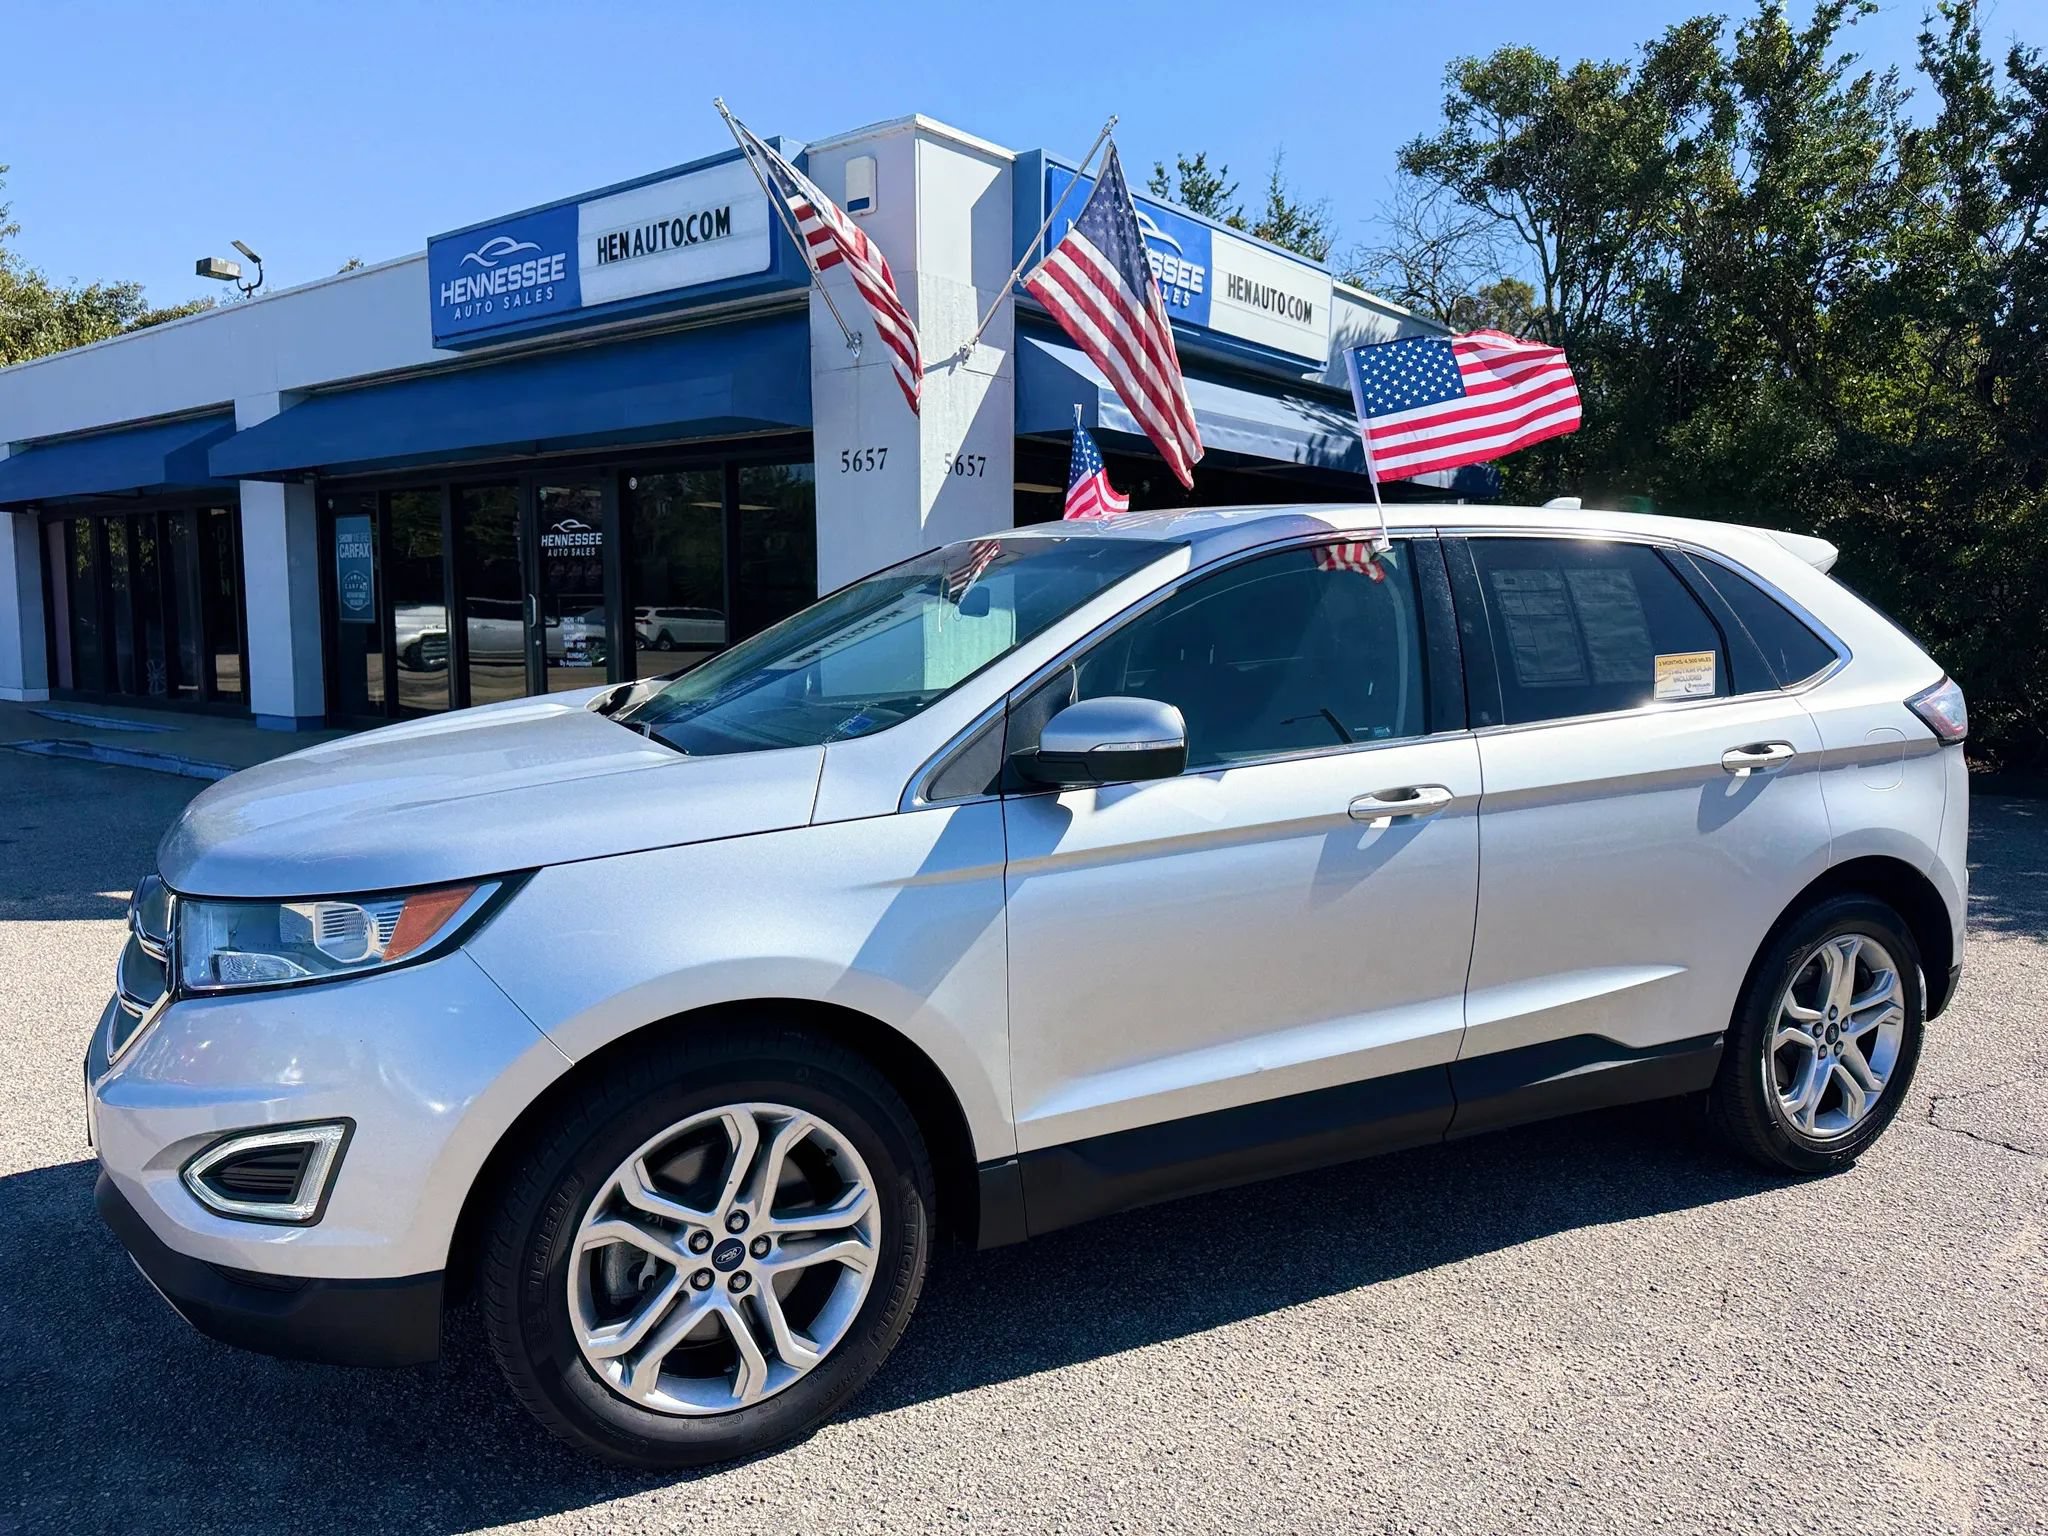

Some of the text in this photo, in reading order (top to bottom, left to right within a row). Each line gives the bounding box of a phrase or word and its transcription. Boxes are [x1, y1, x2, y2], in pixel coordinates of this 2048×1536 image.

[440, 252, 566, 307] HENNESSEE
[454, 285, 554, 321] AUTO SALES
[1227, 273, 1312, 325] HENAUTO.COM
[841, 447, 888, 473] 5657
[944, 452, 986, 478] 5657
[339, 542, 370, 559] CARFAX
[541, 532, 603, 548] HENNESSEE
[547, 547, 596, 557] AUTO SALES
